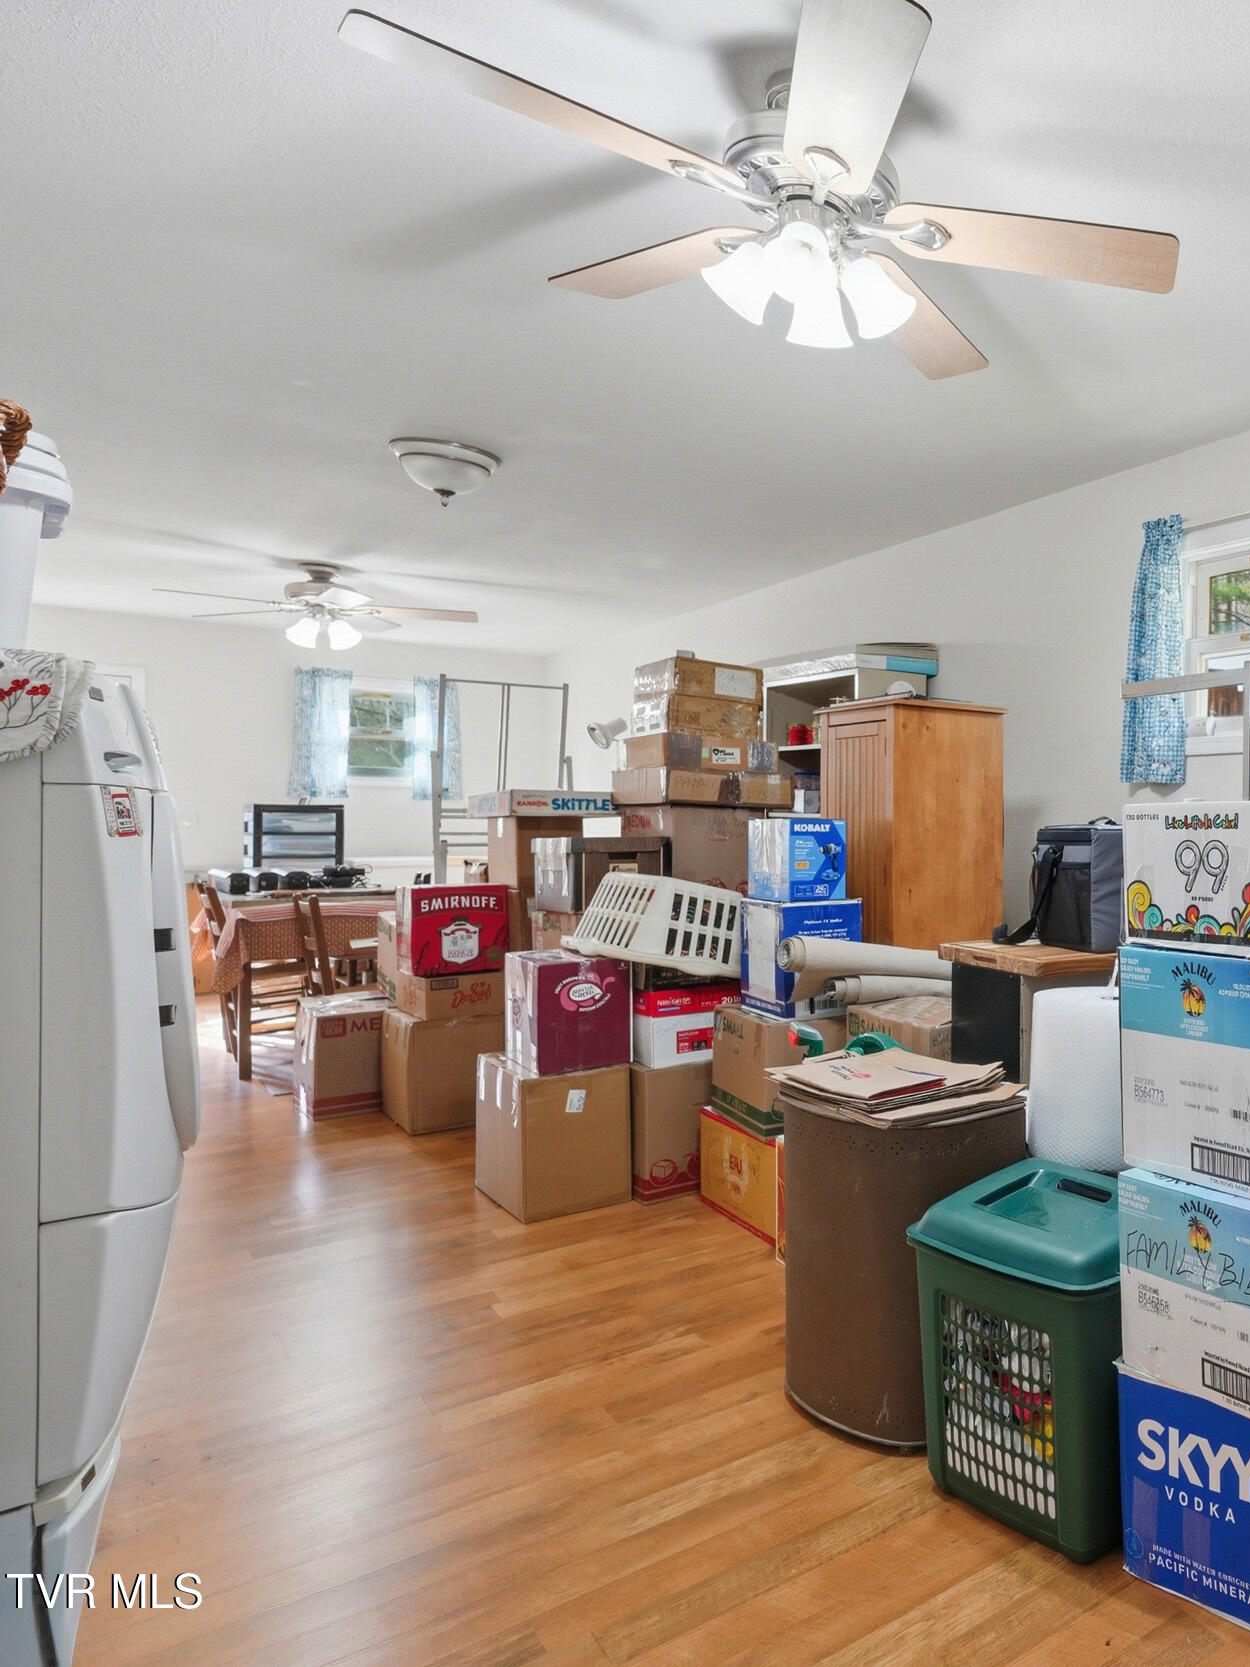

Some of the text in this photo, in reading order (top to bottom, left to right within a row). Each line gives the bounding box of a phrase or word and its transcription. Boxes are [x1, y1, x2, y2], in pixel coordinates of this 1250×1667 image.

[794, 823, 831, 833] KOBALT
[1136, 813, 1160, 821] BOTTLES
[1175, 839, 1230, 895] 99
[1171, 961, 1217, 987] MALIBU
[1180, 1200, 1222, 1229] MALIBU
[1126, 1230, 1211, 1290] FAMILY
[1164, 1485, 1236, 1525] VODKA
[1148, 1552, 1199, 1583] PACIFIC
[1152, 1543, 1172, 1558] MADE
[1173, 1552, 1191, 1567] WITH
[1192, 1560, 1216, 1577] WATER
